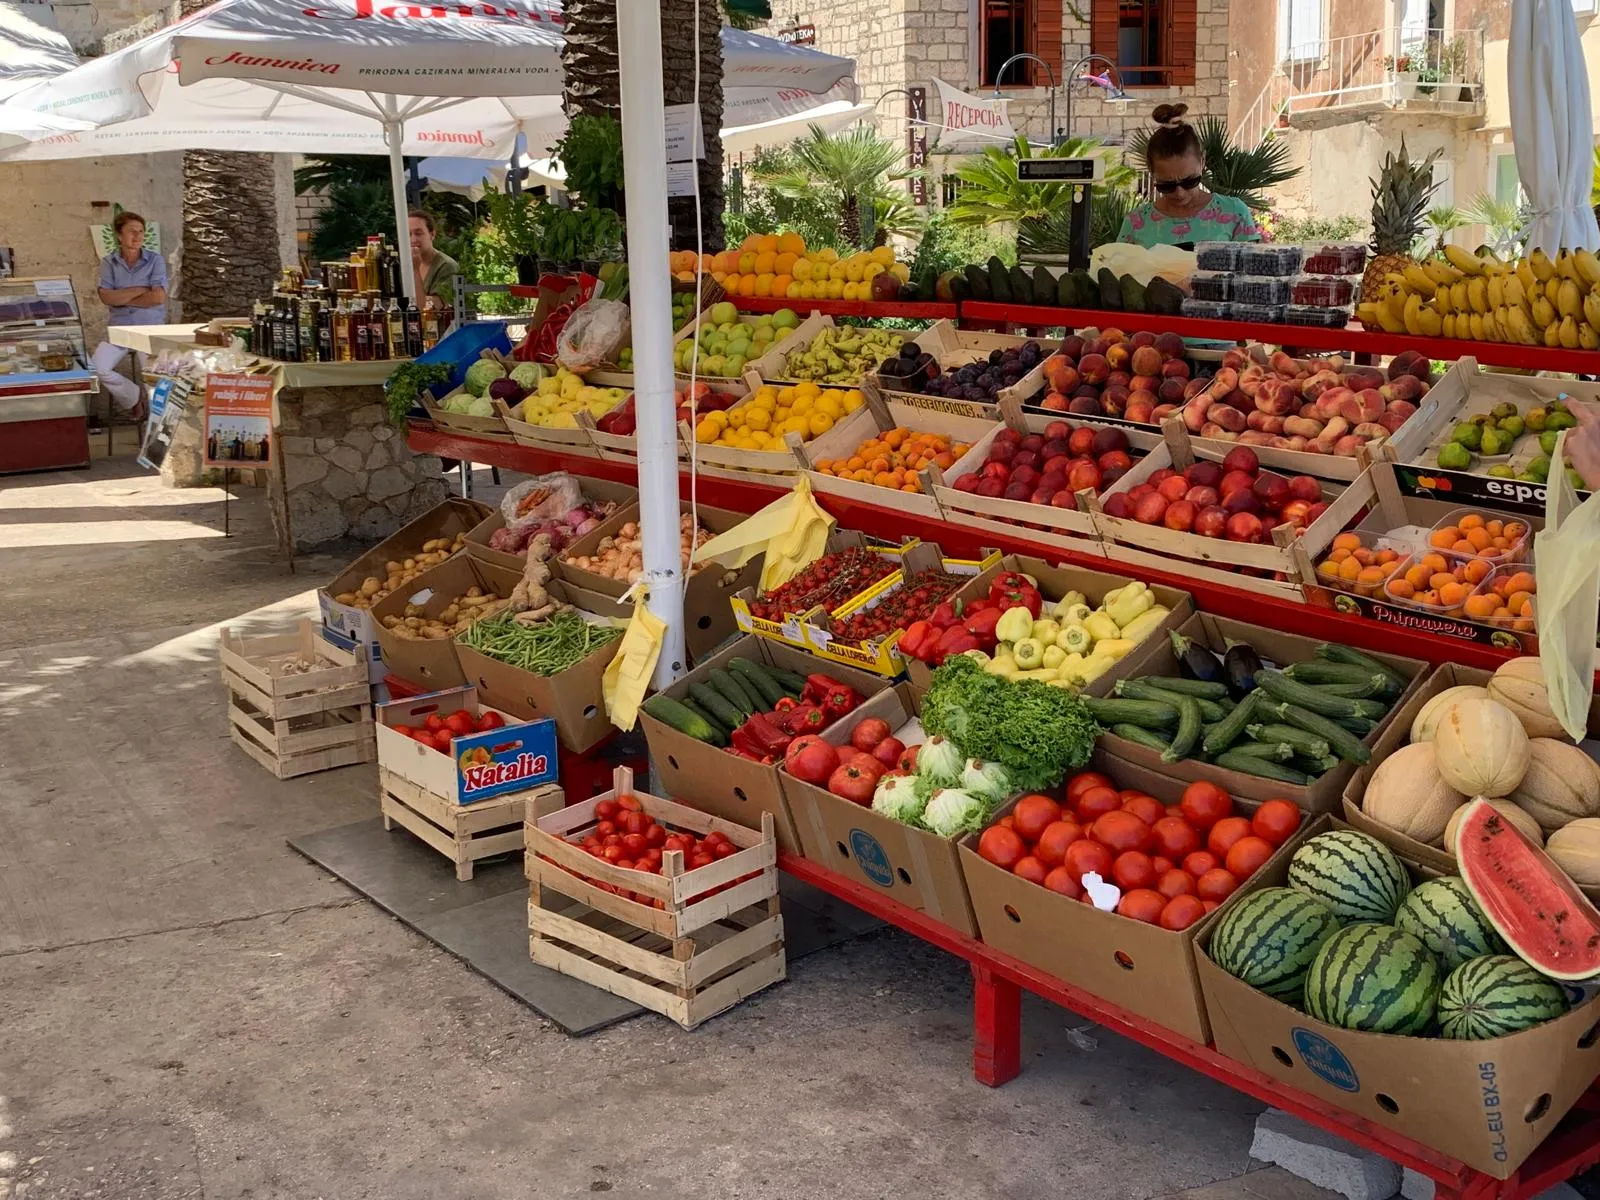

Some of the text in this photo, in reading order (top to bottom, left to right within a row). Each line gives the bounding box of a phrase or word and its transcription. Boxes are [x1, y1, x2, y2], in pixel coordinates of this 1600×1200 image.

[205, 52, 341, 74] Jamnica
[358, 68, 410, 76] PRIRODNA
[414, 68, 463, 76] GAZIRANA
[467, 67, 521, 75] MINERALNA
[1373, 605, 1477, 638] Primavera
[464, 752, 548, 792] Natalia
[1479, 1062, 1499, 1107] BX-05
